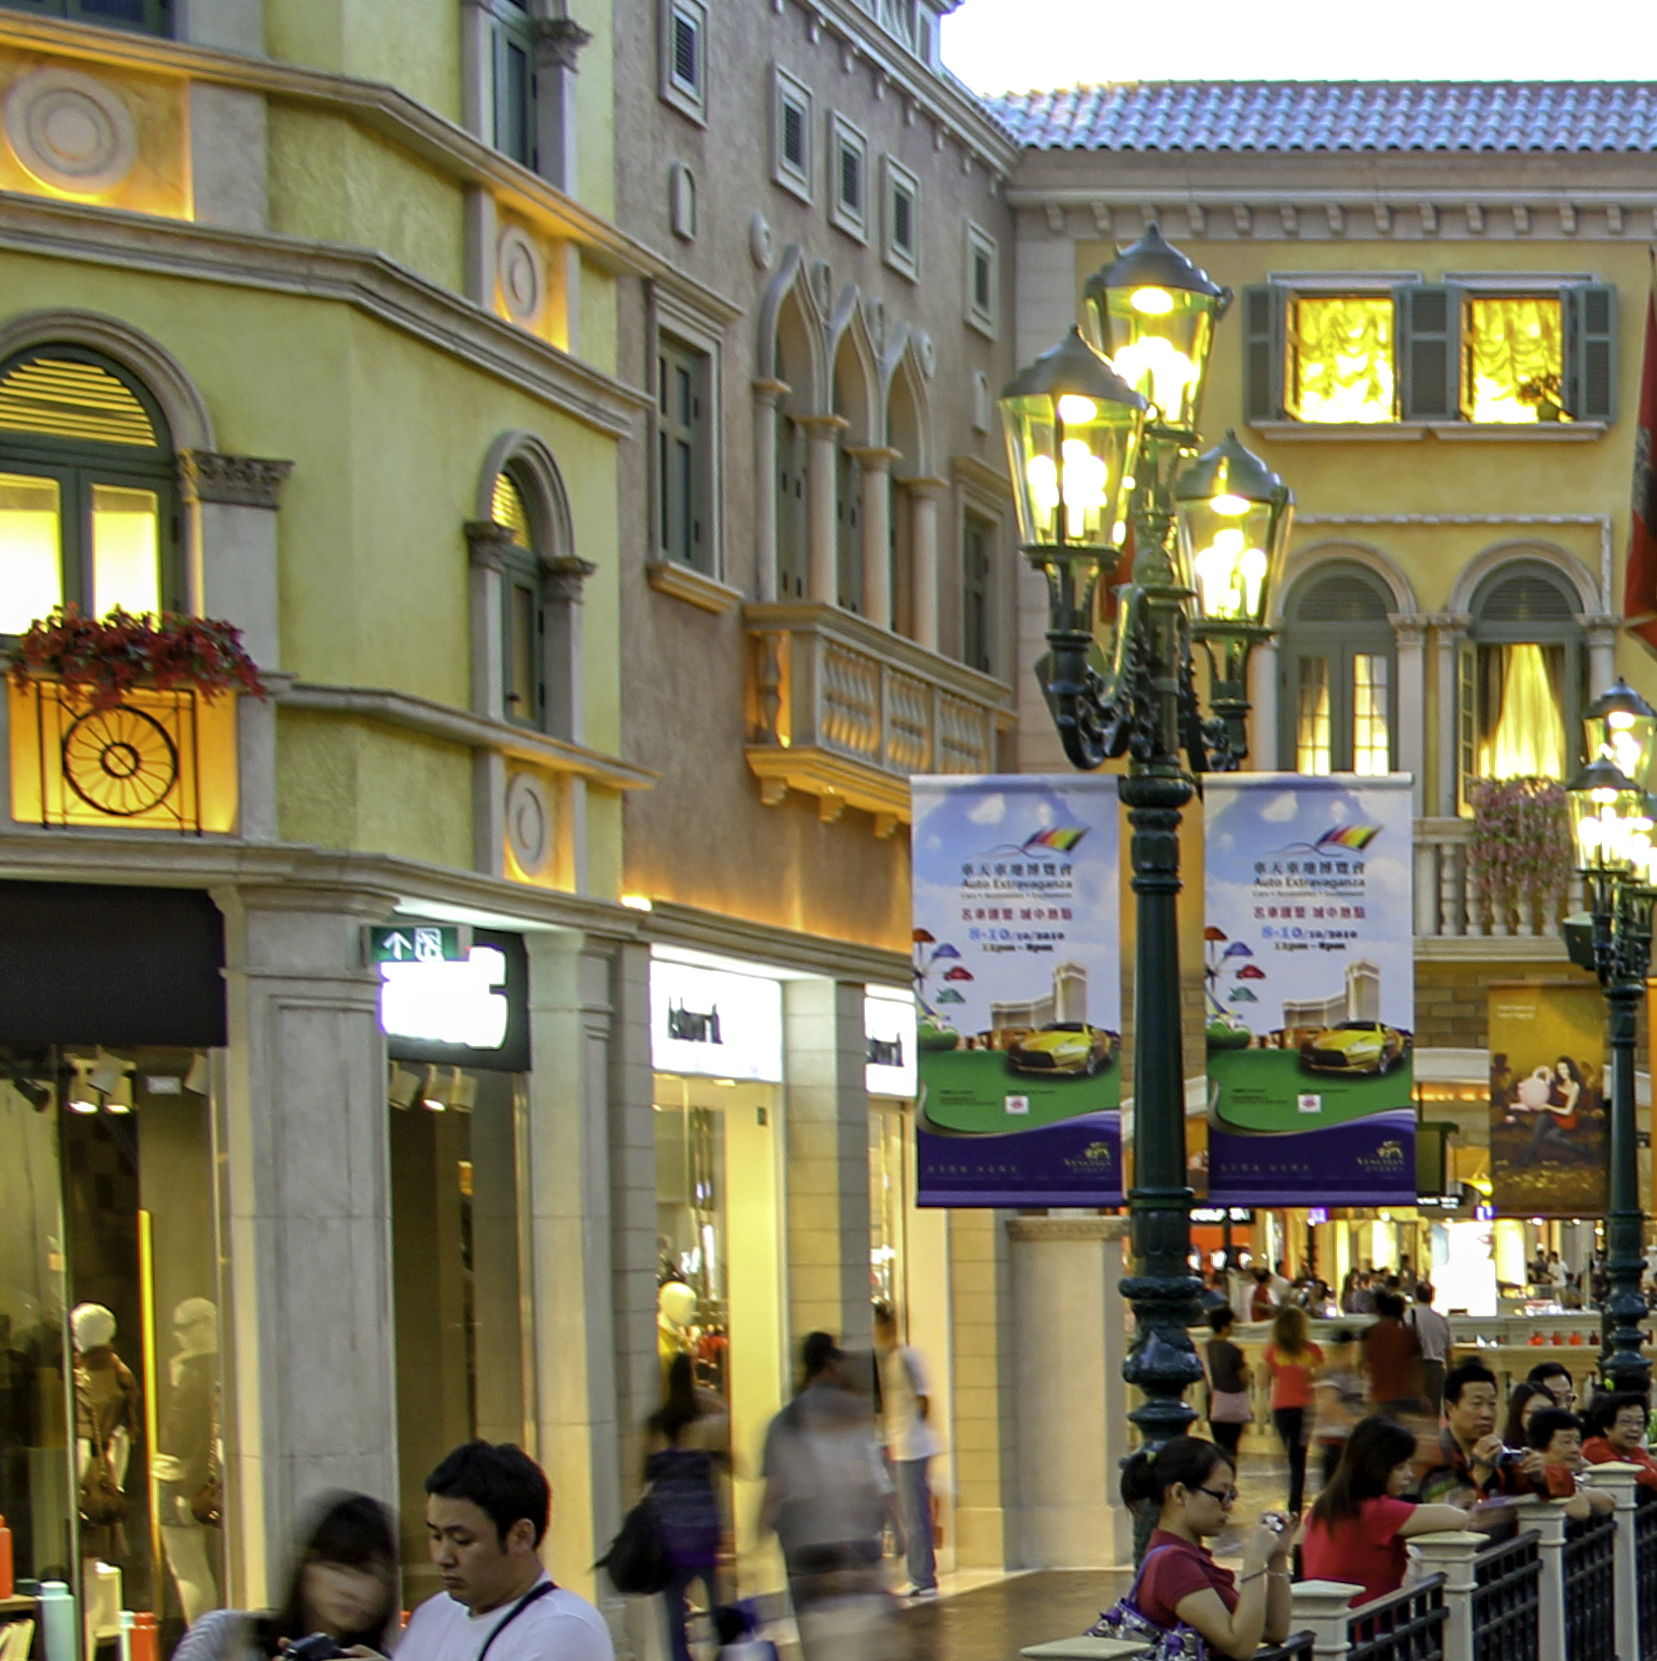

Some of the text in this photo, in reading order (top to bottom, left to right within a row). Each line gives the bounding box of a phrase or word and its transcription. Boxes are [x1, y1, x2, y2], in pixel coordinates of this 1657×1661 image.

[961, 879, 1073, 891] Auto Extravaganza
[1254, 877, 1365, 890] Auto Extravaganza
